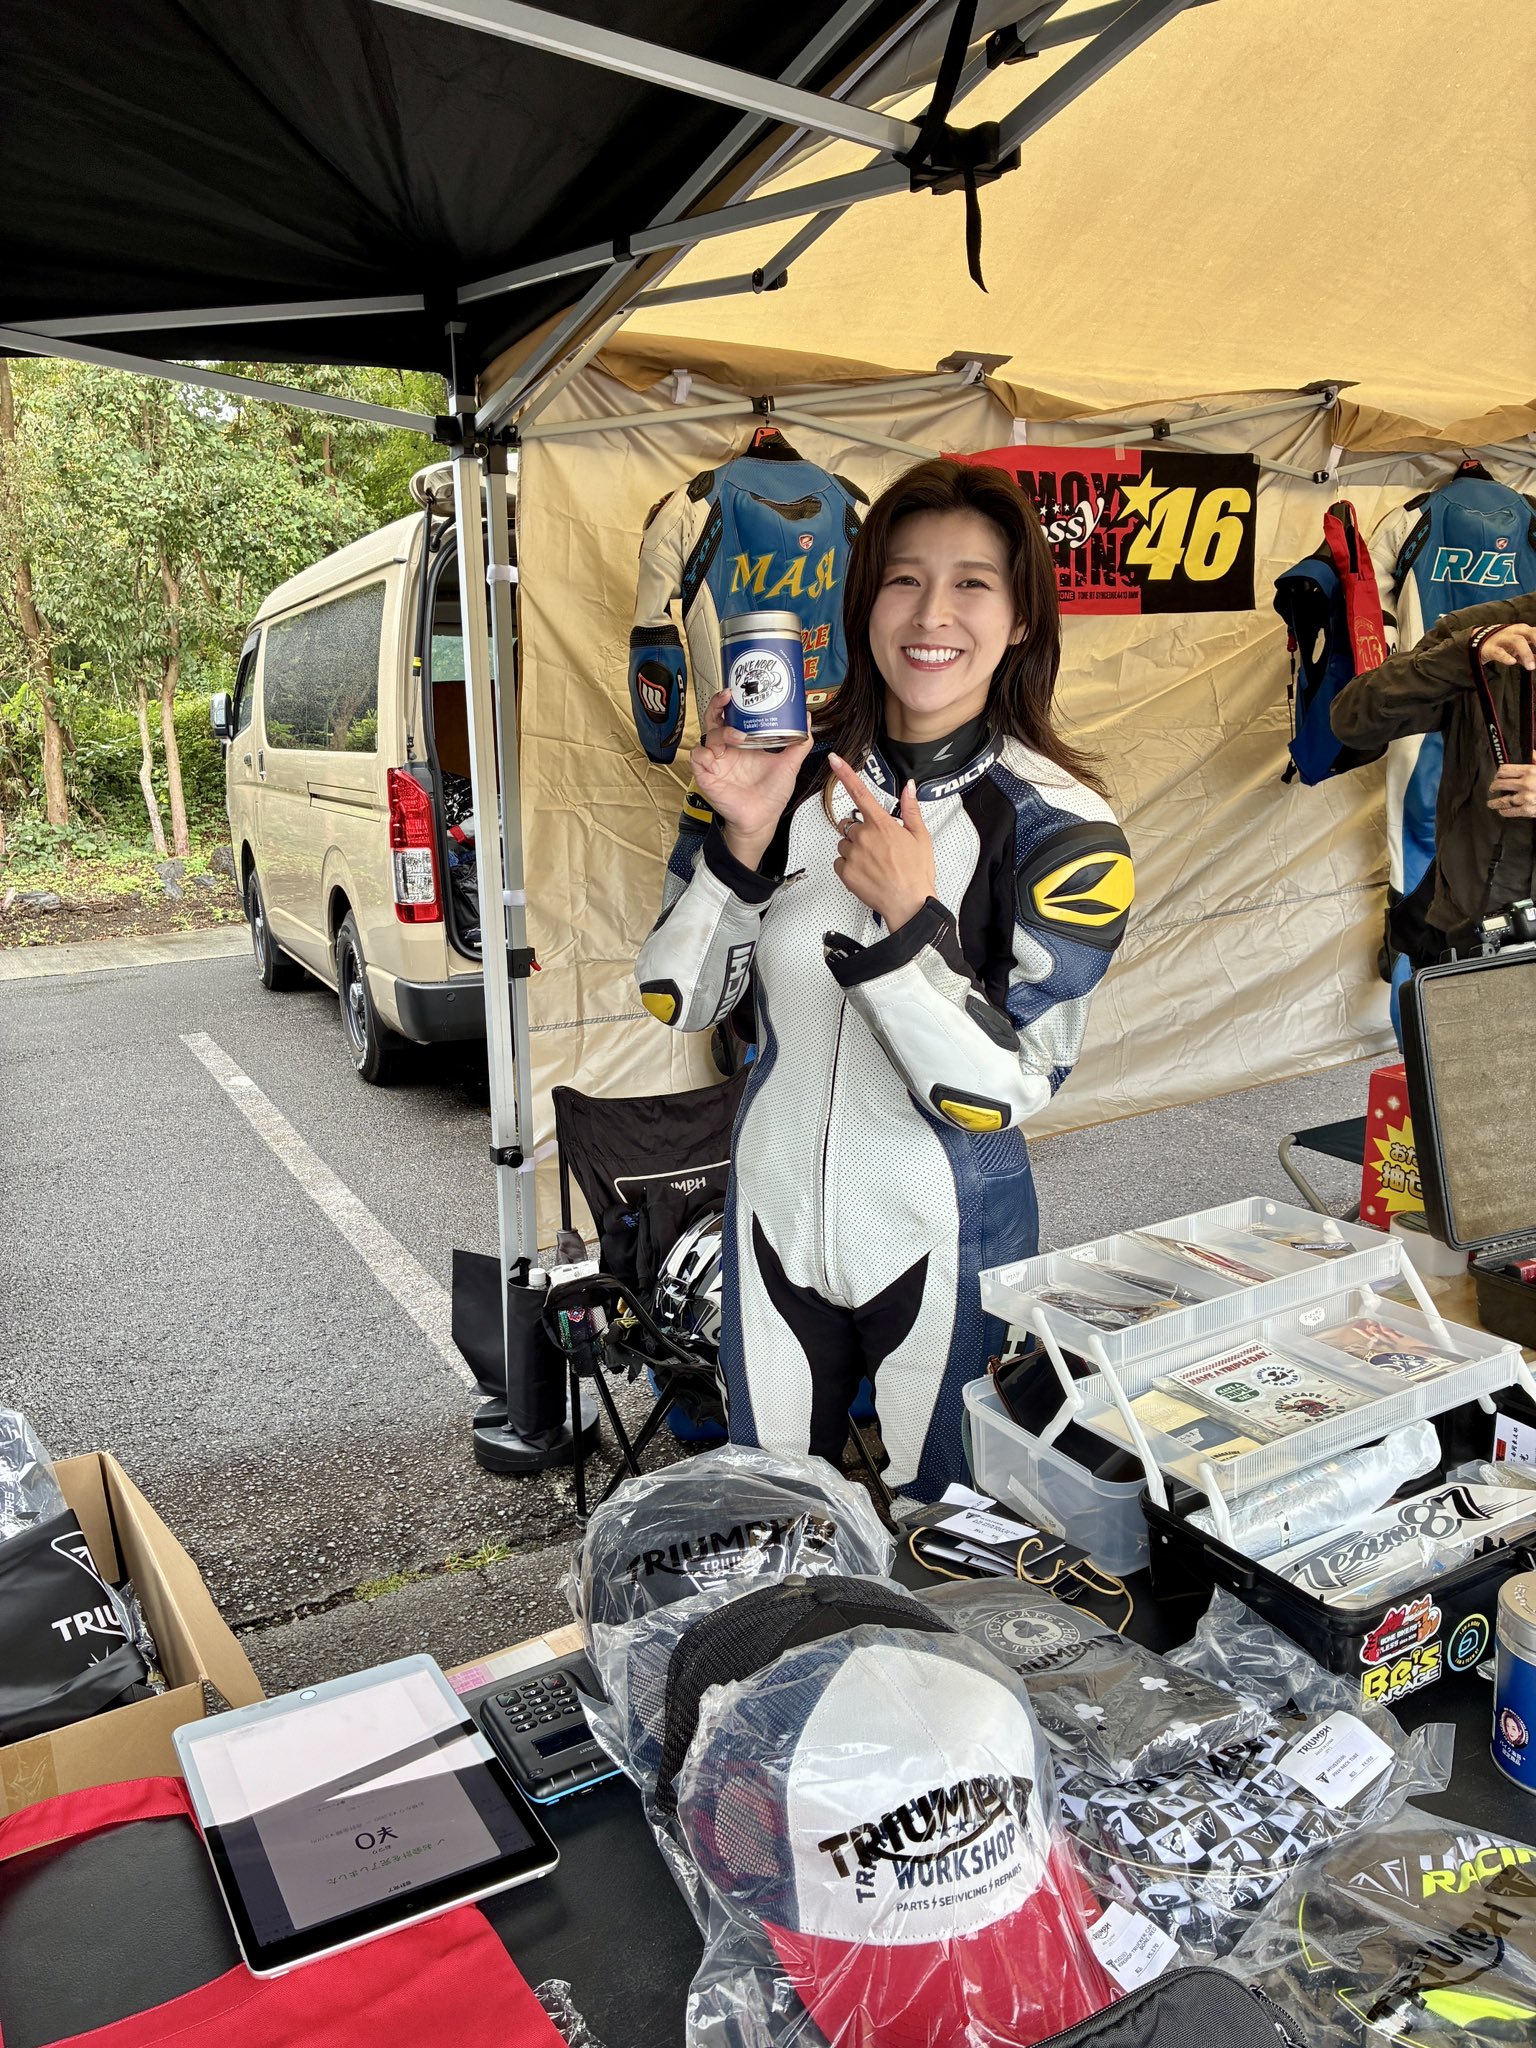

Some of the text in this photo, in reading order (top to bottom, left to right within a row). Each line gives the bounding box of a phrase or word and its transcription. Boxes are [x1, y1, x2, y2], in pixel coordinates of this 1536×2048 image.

[1126, 486, 1251, 581] 46
[930, 752, 995, 798] TAICHI
[671, 1176, 707, 1197] MPH
[1187, 1370, 1216, 1387] HAVE
[1215, 1368, 1223, 1378] A
[1221, 1355, 1252, 1376] TRIPLE
[988, 1610, 1057, 1639] ACE CAFE
[1012, 1627, 1076, 1654] TRIUMPH
[1297, 1725, 1332, 1756] TRIUMPH
[354, 1826, 399, 1851] ¥0
[892, 1821, 1017, 1891] WORKSHOP
[896, 1863, 1022, 1912] PARTS SERVICING REPAIRS
[1131, 1936, 1146, 1953] TRUCKER
[1145, 1923, 1153, 1937] CAP
